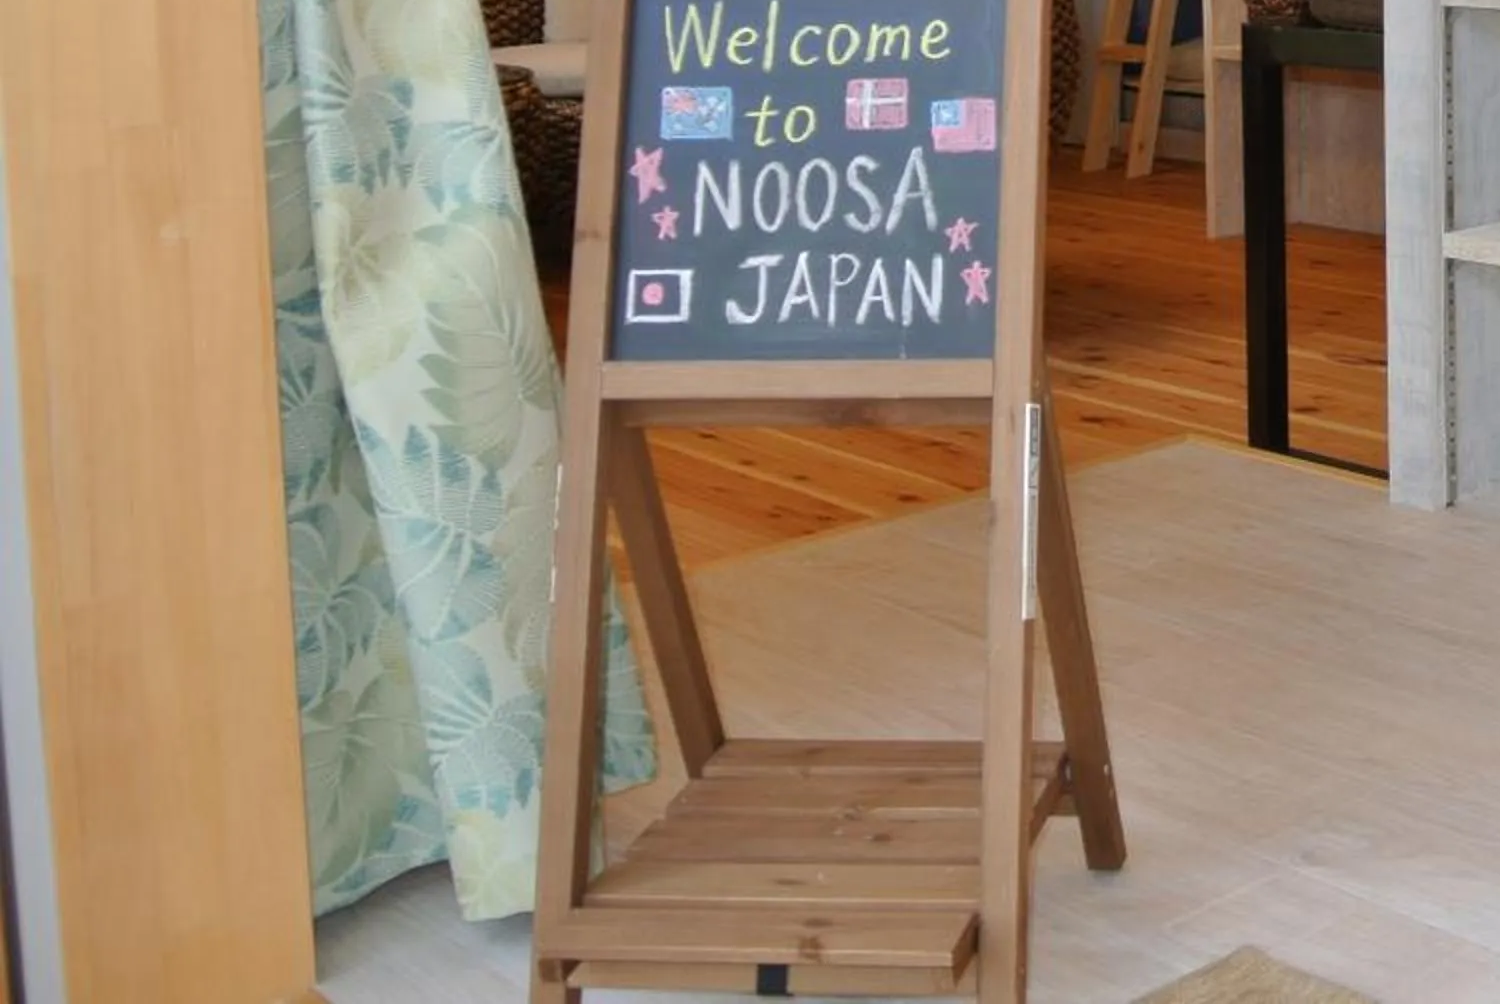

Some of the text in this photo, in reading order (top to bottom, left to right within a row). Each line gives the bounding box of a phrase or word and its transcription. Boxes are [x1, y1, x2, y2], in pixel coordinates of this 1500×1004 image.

[663, 0, 952, 74] Welcome
[744, 95, 817, 147] to
[693, 146, 938, 237] NOOSA
[725, 251, 944, 327] JAPAN
